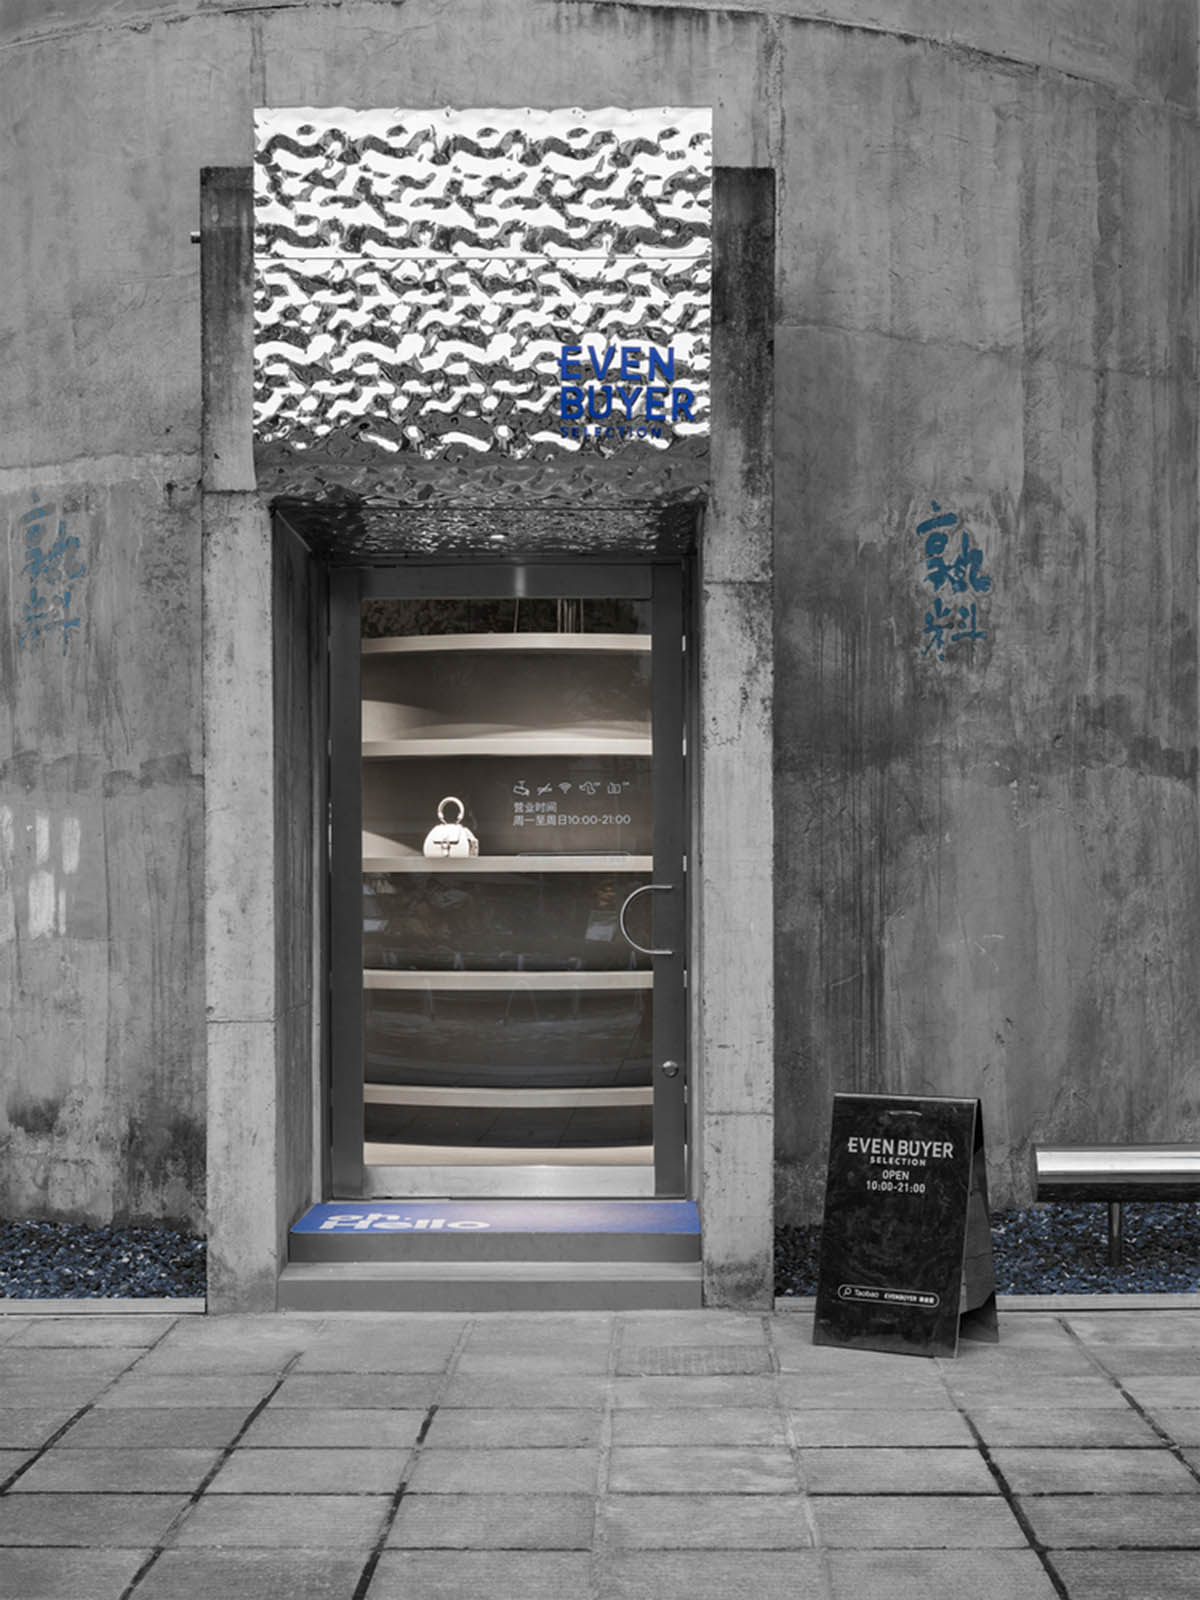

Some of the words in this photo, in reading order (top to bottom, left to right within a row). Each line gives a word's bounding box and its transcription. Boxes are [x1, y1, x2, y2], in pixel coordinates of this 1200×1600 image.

[557, 345, 675, 381] EVEN
[560, 385, 696, 421] BUYER
[560, 426, 662, 438] SELECTION
[848, 1136, 895, 1155] EVEN
[897, 1139, 954, 1158] BUYER
[870, 1156, 926, 1167] SELECTION
[882, 1169, 909, 1180] OPEN
[866, 1180, 926, 1194] 10:00-21:00
